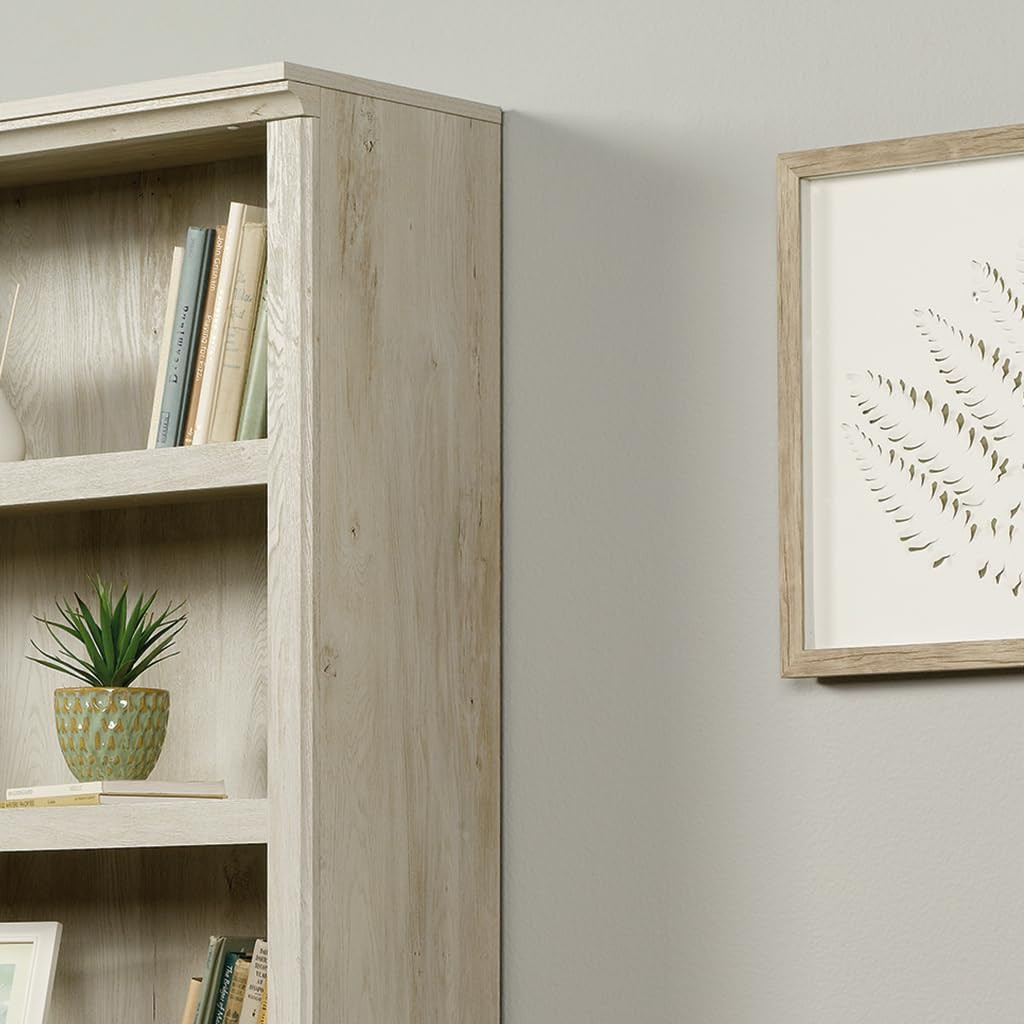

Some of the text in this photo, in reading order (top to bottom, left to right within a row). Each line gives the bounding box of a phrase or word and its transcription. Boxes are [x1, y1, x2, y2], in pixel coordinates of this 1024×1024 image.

[211, 235, 224, 291] John Grisham
[203, 314, 213, 344] Playing
[225, 965, 233, 978] The
[219, 978, 230, 1002] Bridges
